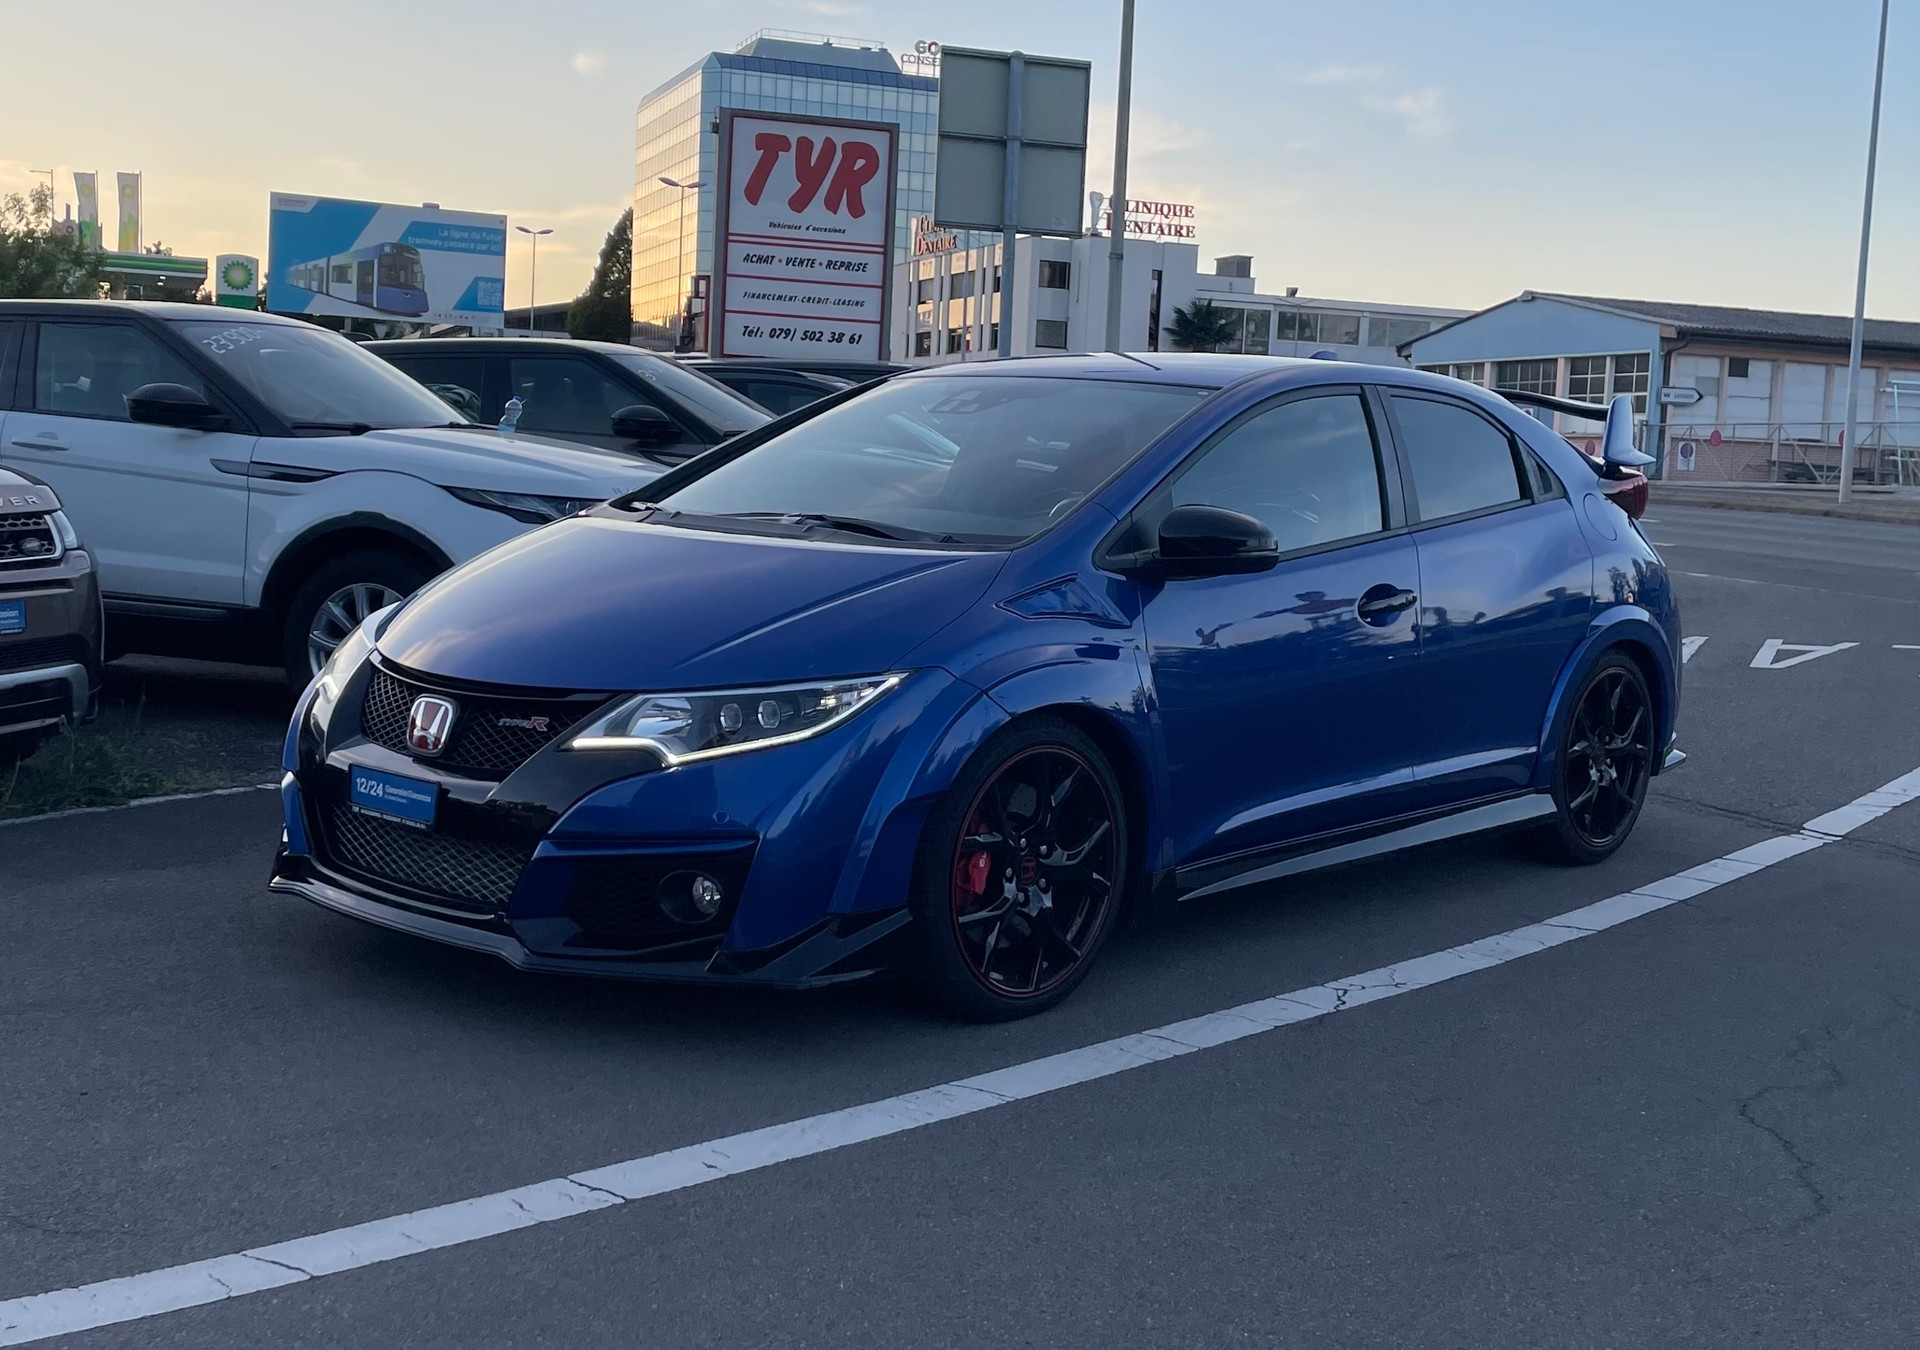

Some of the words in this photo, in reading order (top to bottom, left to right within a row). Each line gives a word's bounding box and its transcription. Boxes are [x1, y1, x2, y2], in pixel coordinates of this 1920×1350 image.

[744, 132, 880, 219] TYR
[743, 253, 775, 266] ACHAT
[785, 256, 816, 269] VENTE
[825, 260, 869, 273] REPRISE
[801, 330, 824, 342] 502
[828, 331, 846, 343] 38
[848, 333, 863, 345] 61
[355, 777, 384, 798] 12/24
